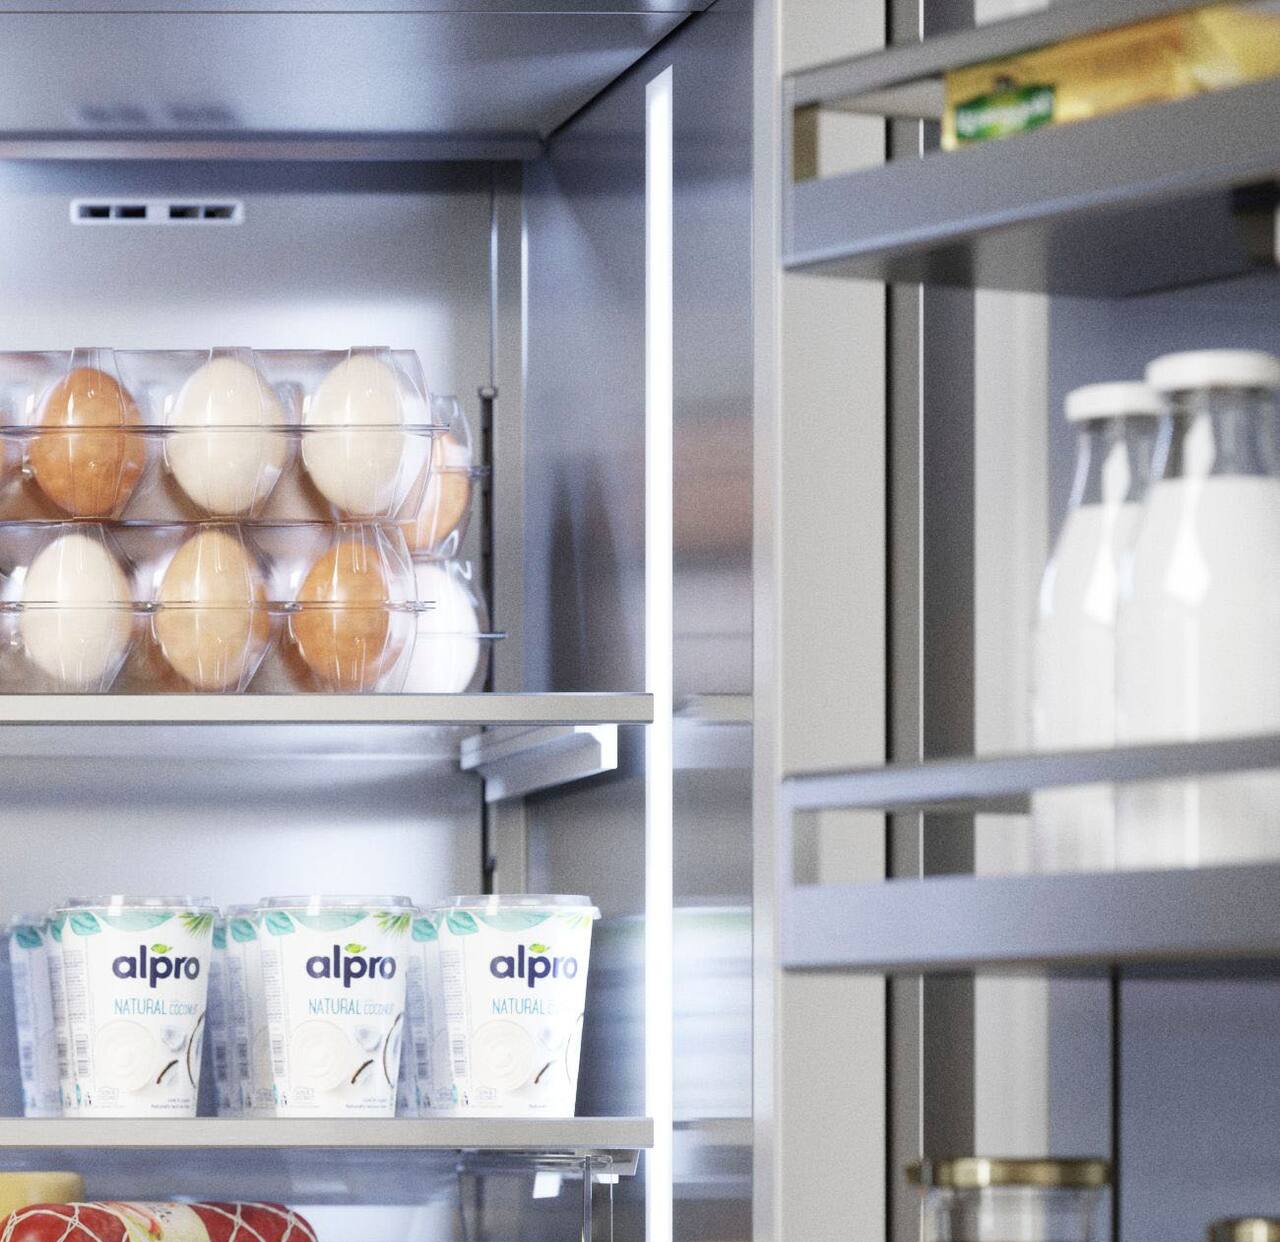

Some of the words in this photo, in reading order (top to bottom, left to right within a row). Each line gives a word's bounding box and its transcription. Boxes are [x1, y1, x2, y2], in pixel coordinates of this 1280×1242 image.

[112, 944, 200, 988] alpro
[306, 944, 397, 988] alpro
[490, 944, 578, 988] alpro
[114, 998, 168, 1015] NATURAL
[309, 998, 361, 1015] NATURAL
[492, 998, 545, 1015] NATURAL
